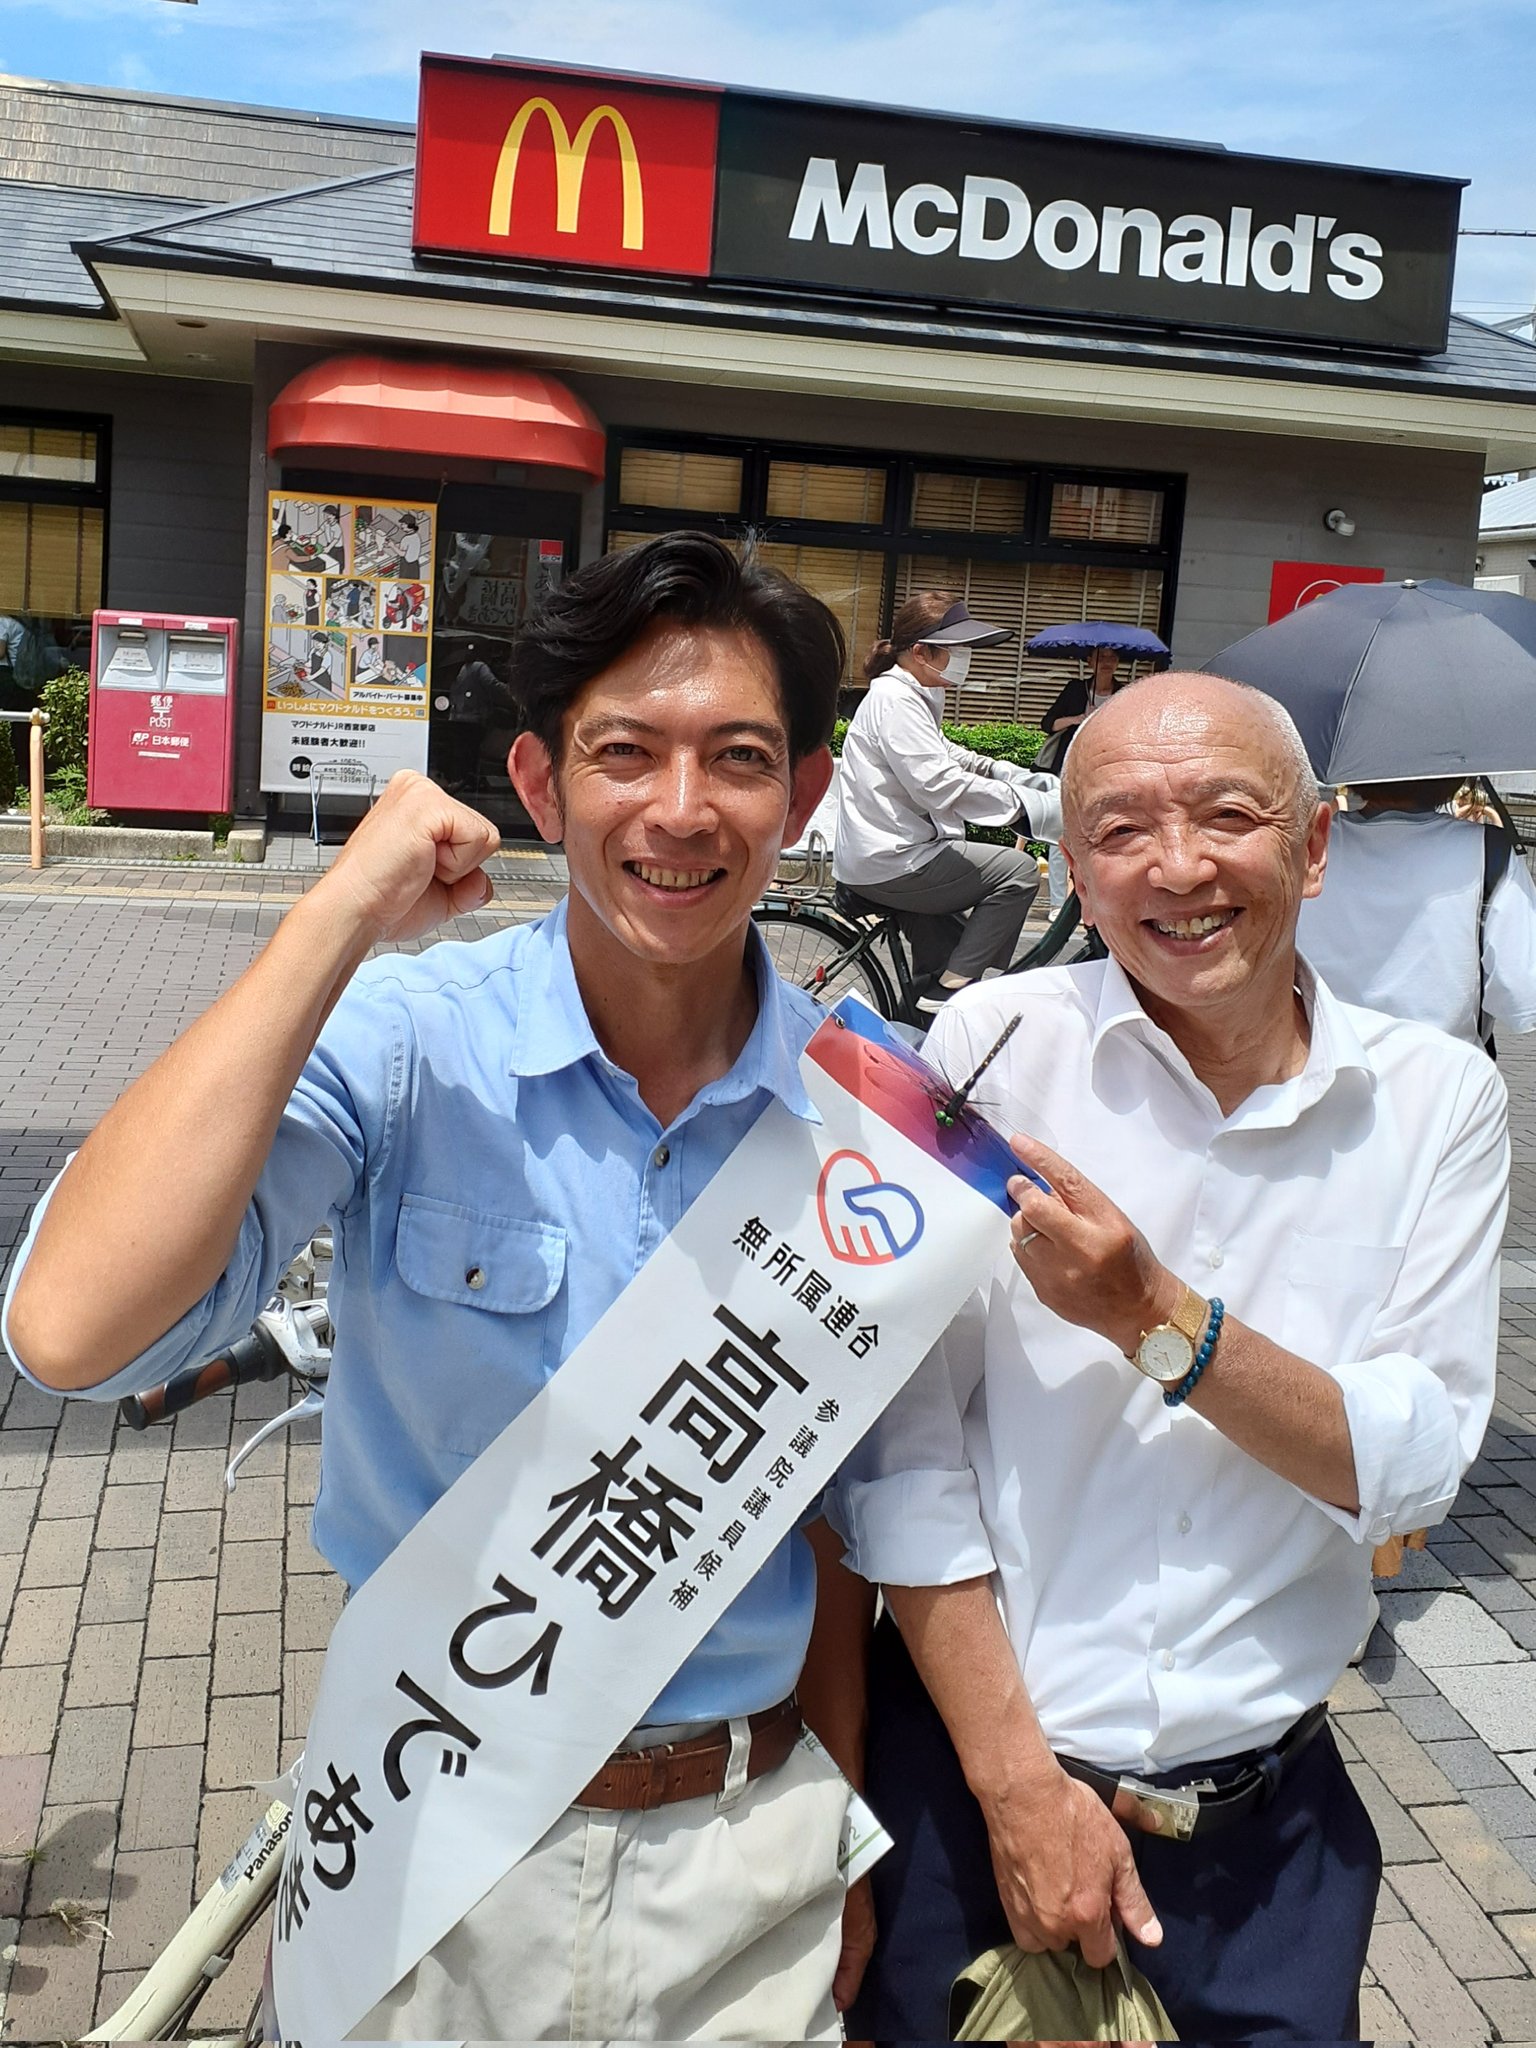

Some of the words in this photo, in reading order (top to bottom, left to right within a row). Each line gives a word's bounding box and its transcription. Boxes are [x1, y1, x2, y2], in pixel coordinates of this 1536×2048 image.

[788, 158, 1384, 301] McDonald's
[149, 717, 172, 728] POST
[150, 695, 173, 707] 郵便
[152, 736, 190, 747] 日本郵便
[732, 1216, 879, 1359] 無所属連合
[668, 1398, 840, 1612] 参議院議員候補
